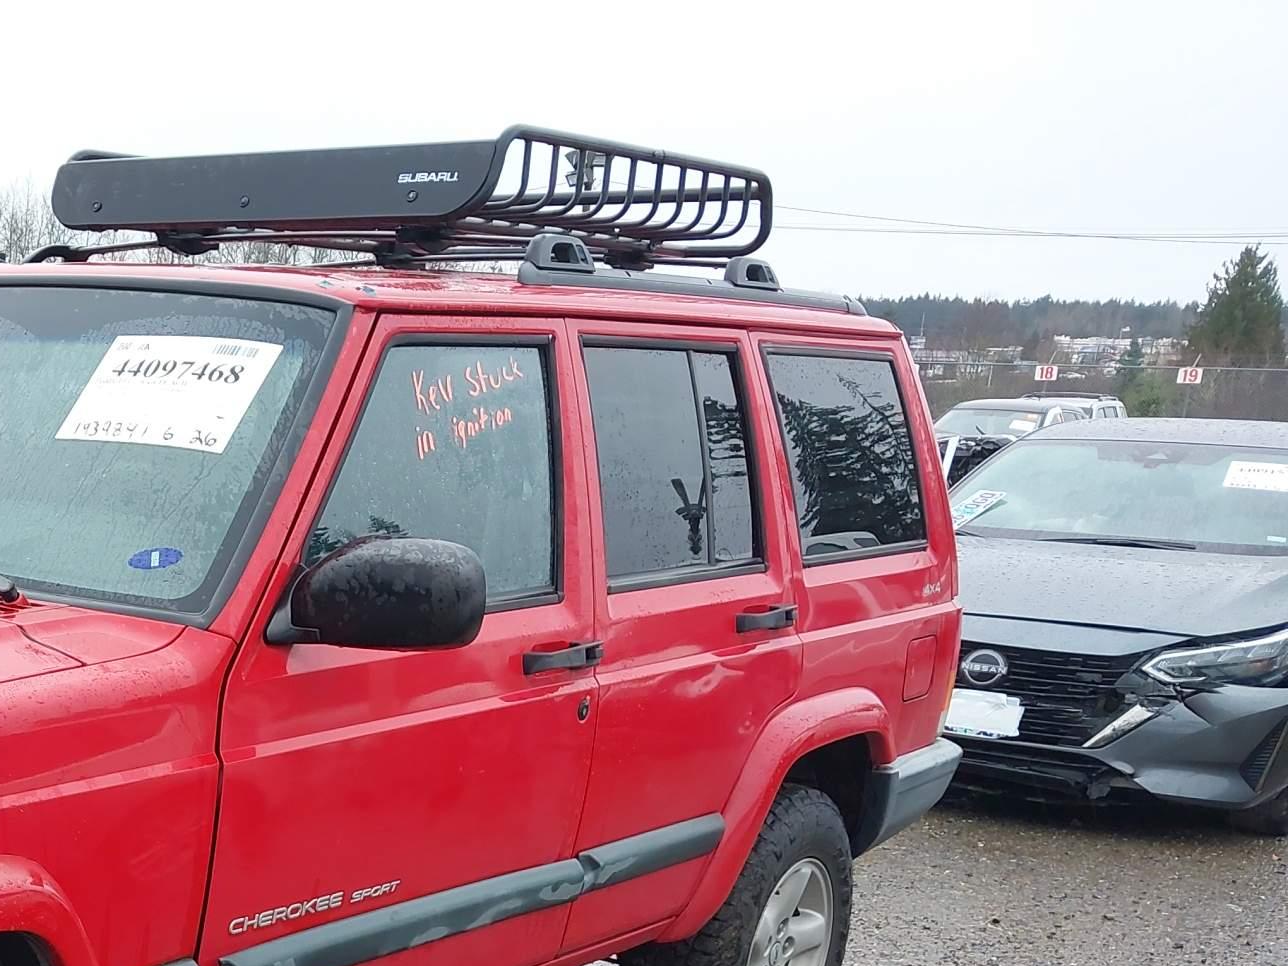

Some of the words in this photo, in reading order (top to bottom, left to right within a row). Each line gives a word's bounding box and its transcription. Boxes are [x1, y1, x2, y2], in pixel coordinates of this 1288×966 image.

[397, 171, 458, 184] SUBARU
[111, 358, 246, 384] 44097468
[1038, 366, 1054, 380] 18
[1181, 368, 1199, 383] 19
[415, 426, 436, 460] in
[452, 407, 512, 449] ignition
[962, 661, 1008, 675] NISSAN
[228, 891, 344, 935] CHEROKEE
[350, 879, 402, 904] SPORT
